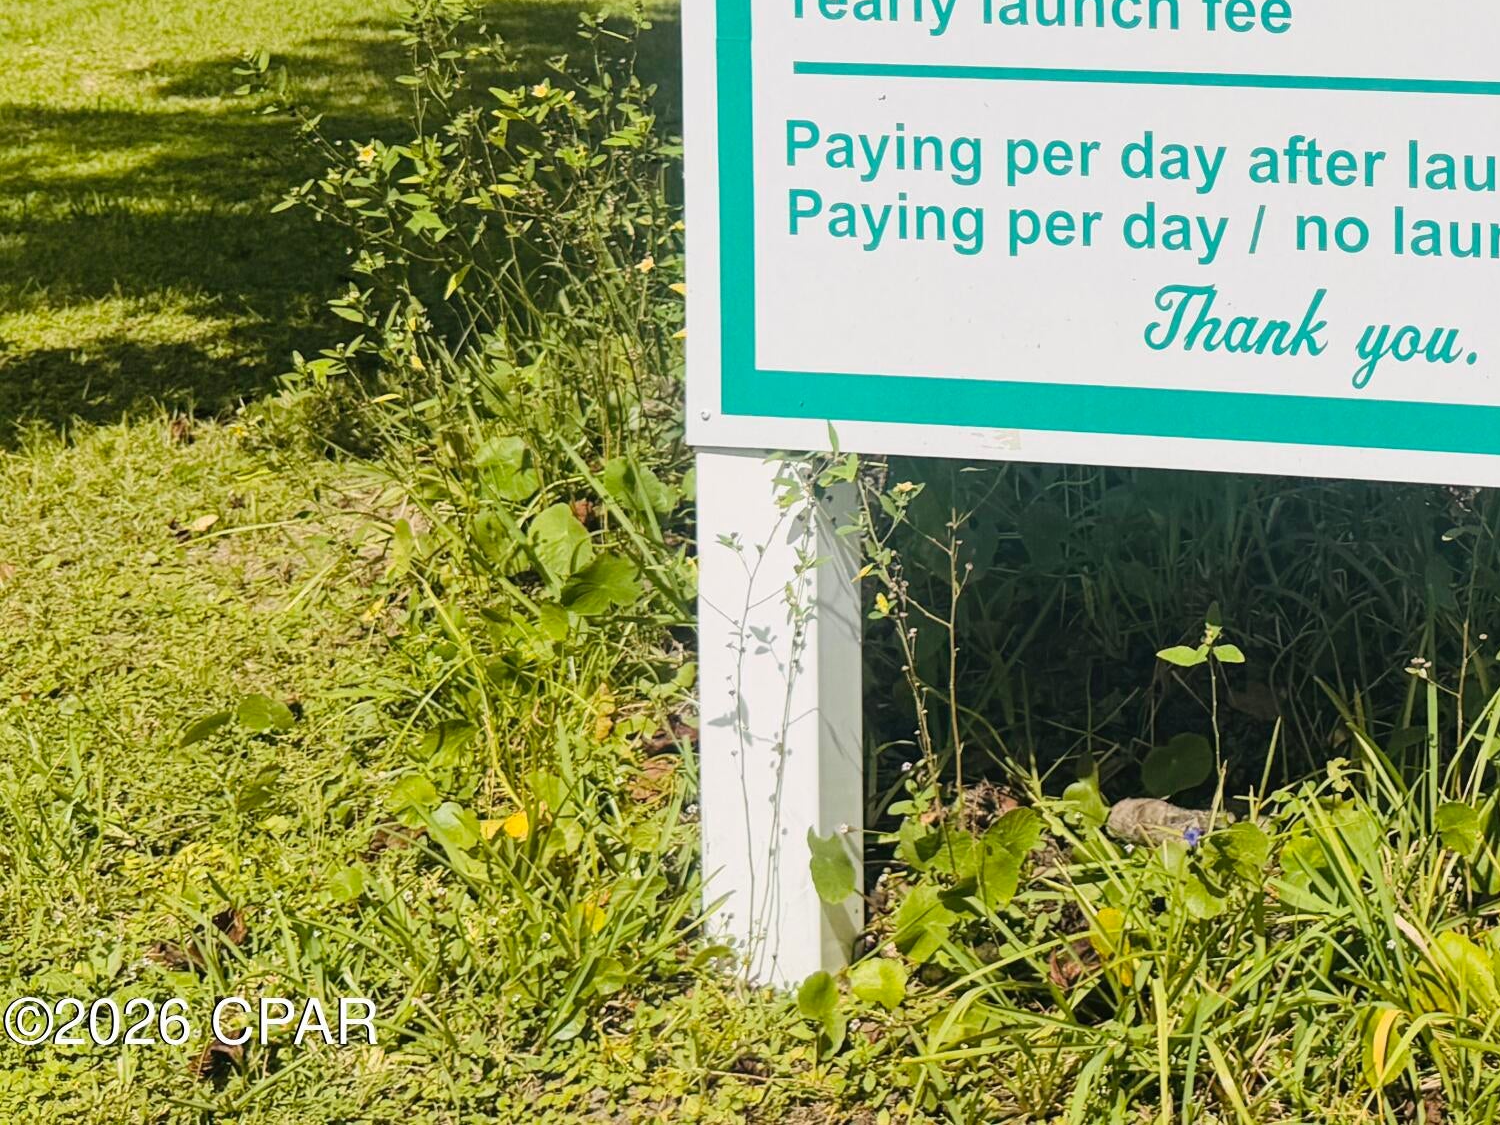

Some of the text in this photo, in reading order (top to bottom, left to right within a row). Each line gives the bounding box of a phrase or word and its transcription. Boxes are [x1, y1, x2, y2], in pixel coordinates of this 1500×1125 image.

[786, 120, 981, 186] Paying
[1007, 140, 1100, 186] per
[1121, 131, 1225, 194] day
[1249, 135, 1385, 186] after
[789, 189, 983, 255] Paying
[1009, 209, 1102, 256] per
[1123, 202, 1228, 265] day
[1250, 206, 1264, 253] /
[1297, 216, 1369, 253] no
[1144, 285, 1326, 356] Thank
[1352, 325, 1476, 389] you.
